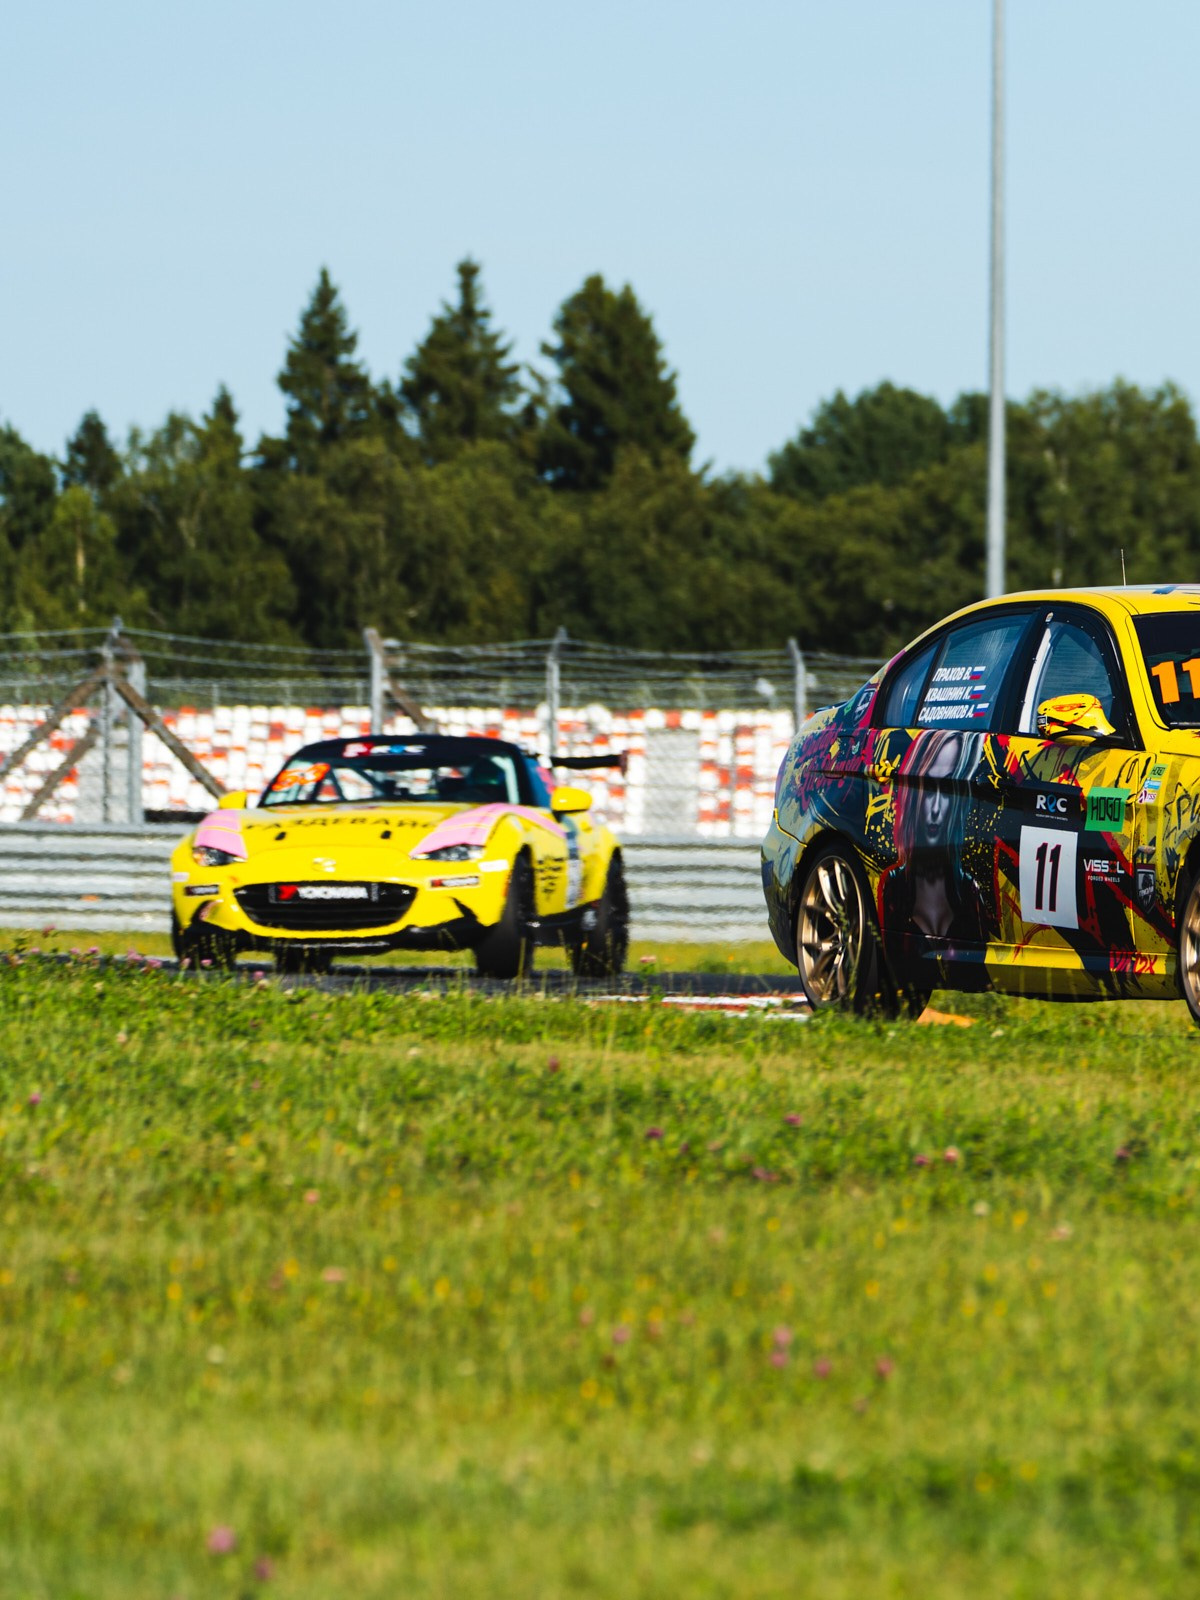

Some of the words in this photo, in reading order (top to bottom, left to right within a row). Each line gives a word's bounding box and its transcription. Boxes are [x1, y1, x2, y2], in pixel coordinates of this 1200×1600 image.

[932, 667, 966, 681] ПРАХОВ
[924, 687, 966, 702] КВАШНИН
[918, 706, 969, 722] САДОВНИКОВ
[1090, 796, 1122, 822] HOGO
[1083, 858, 1125, 874] VISSOL
[1035, 842, 1062, 912] 11
